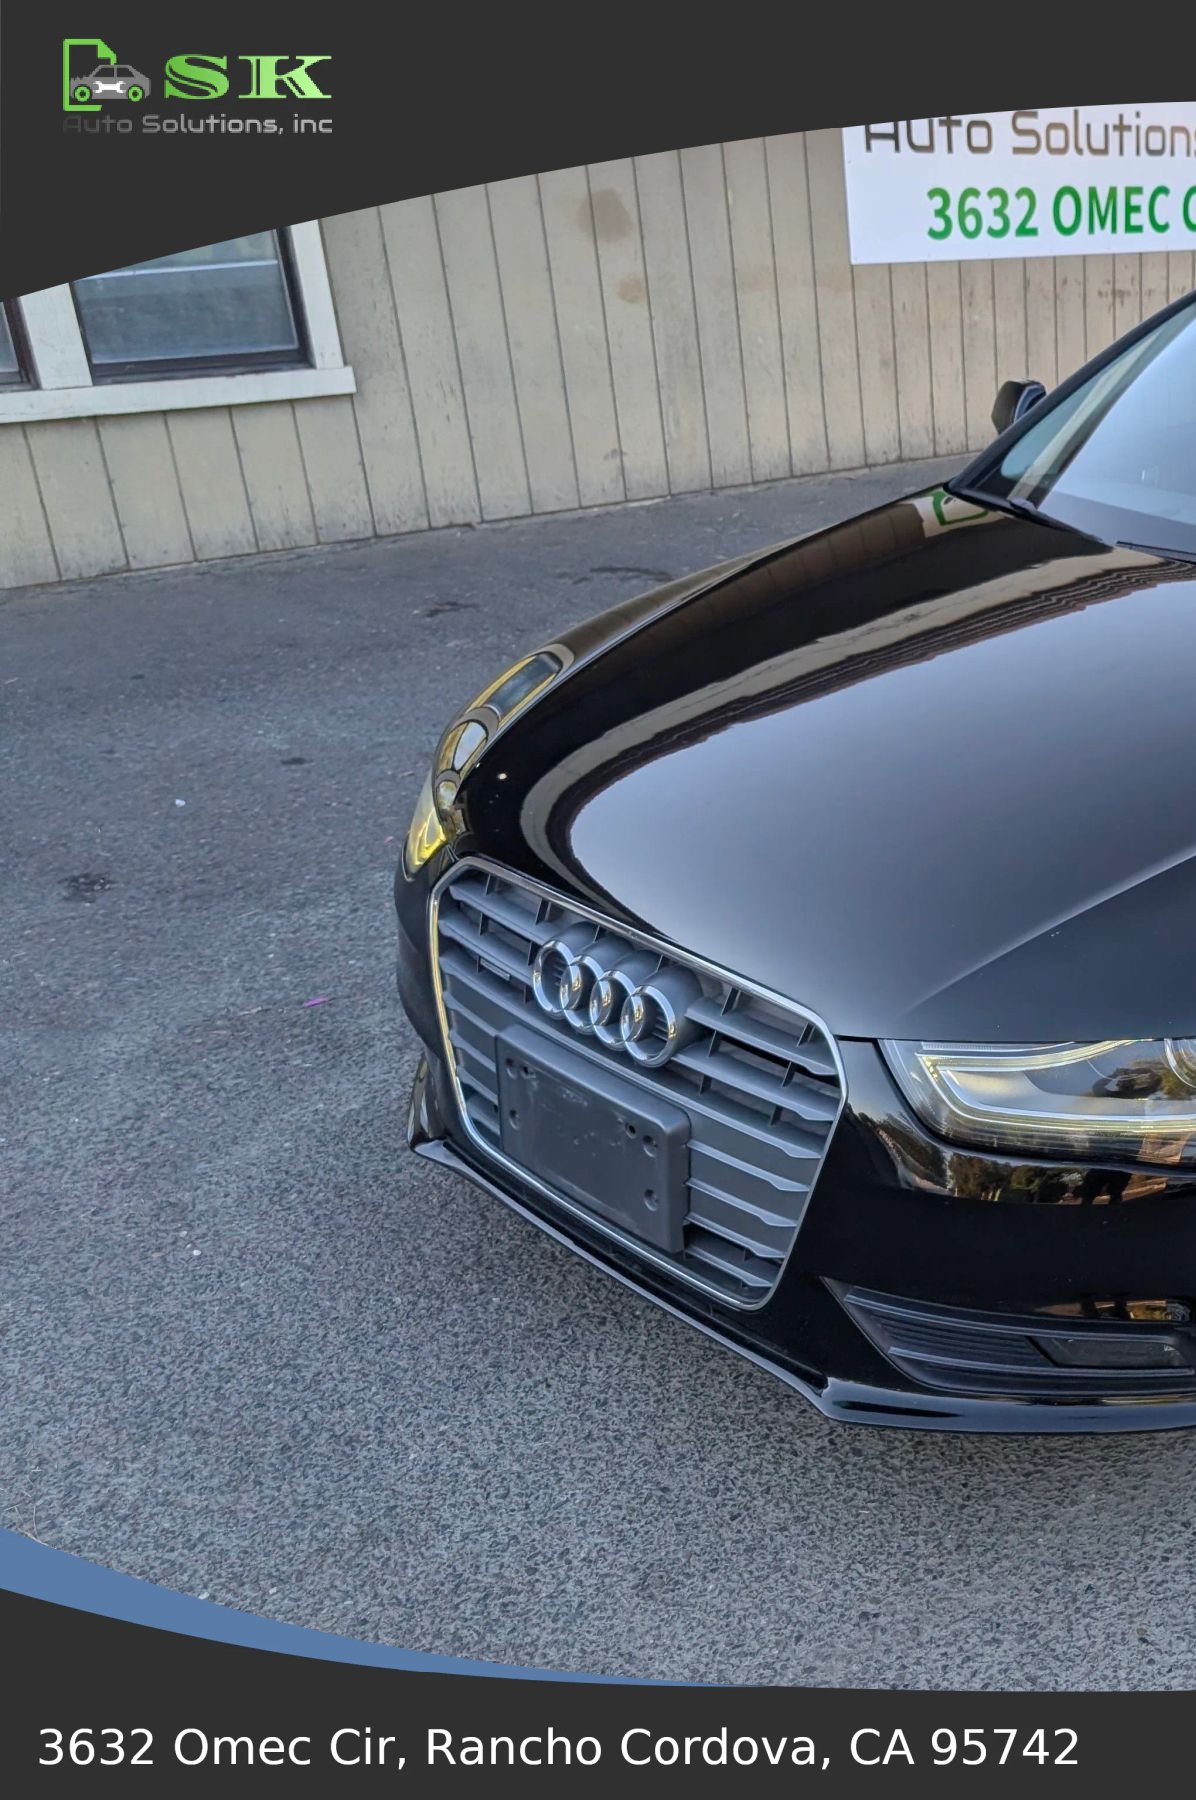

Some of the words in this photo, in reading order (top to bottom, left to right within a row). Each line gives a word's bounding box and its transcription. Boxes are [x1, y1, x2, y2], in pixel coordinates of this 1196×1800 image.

[864, 114, 993, 155] Auto
[926, 185, 1039, 241] 3632
[1051, 184, 1170, 236] OMEC
